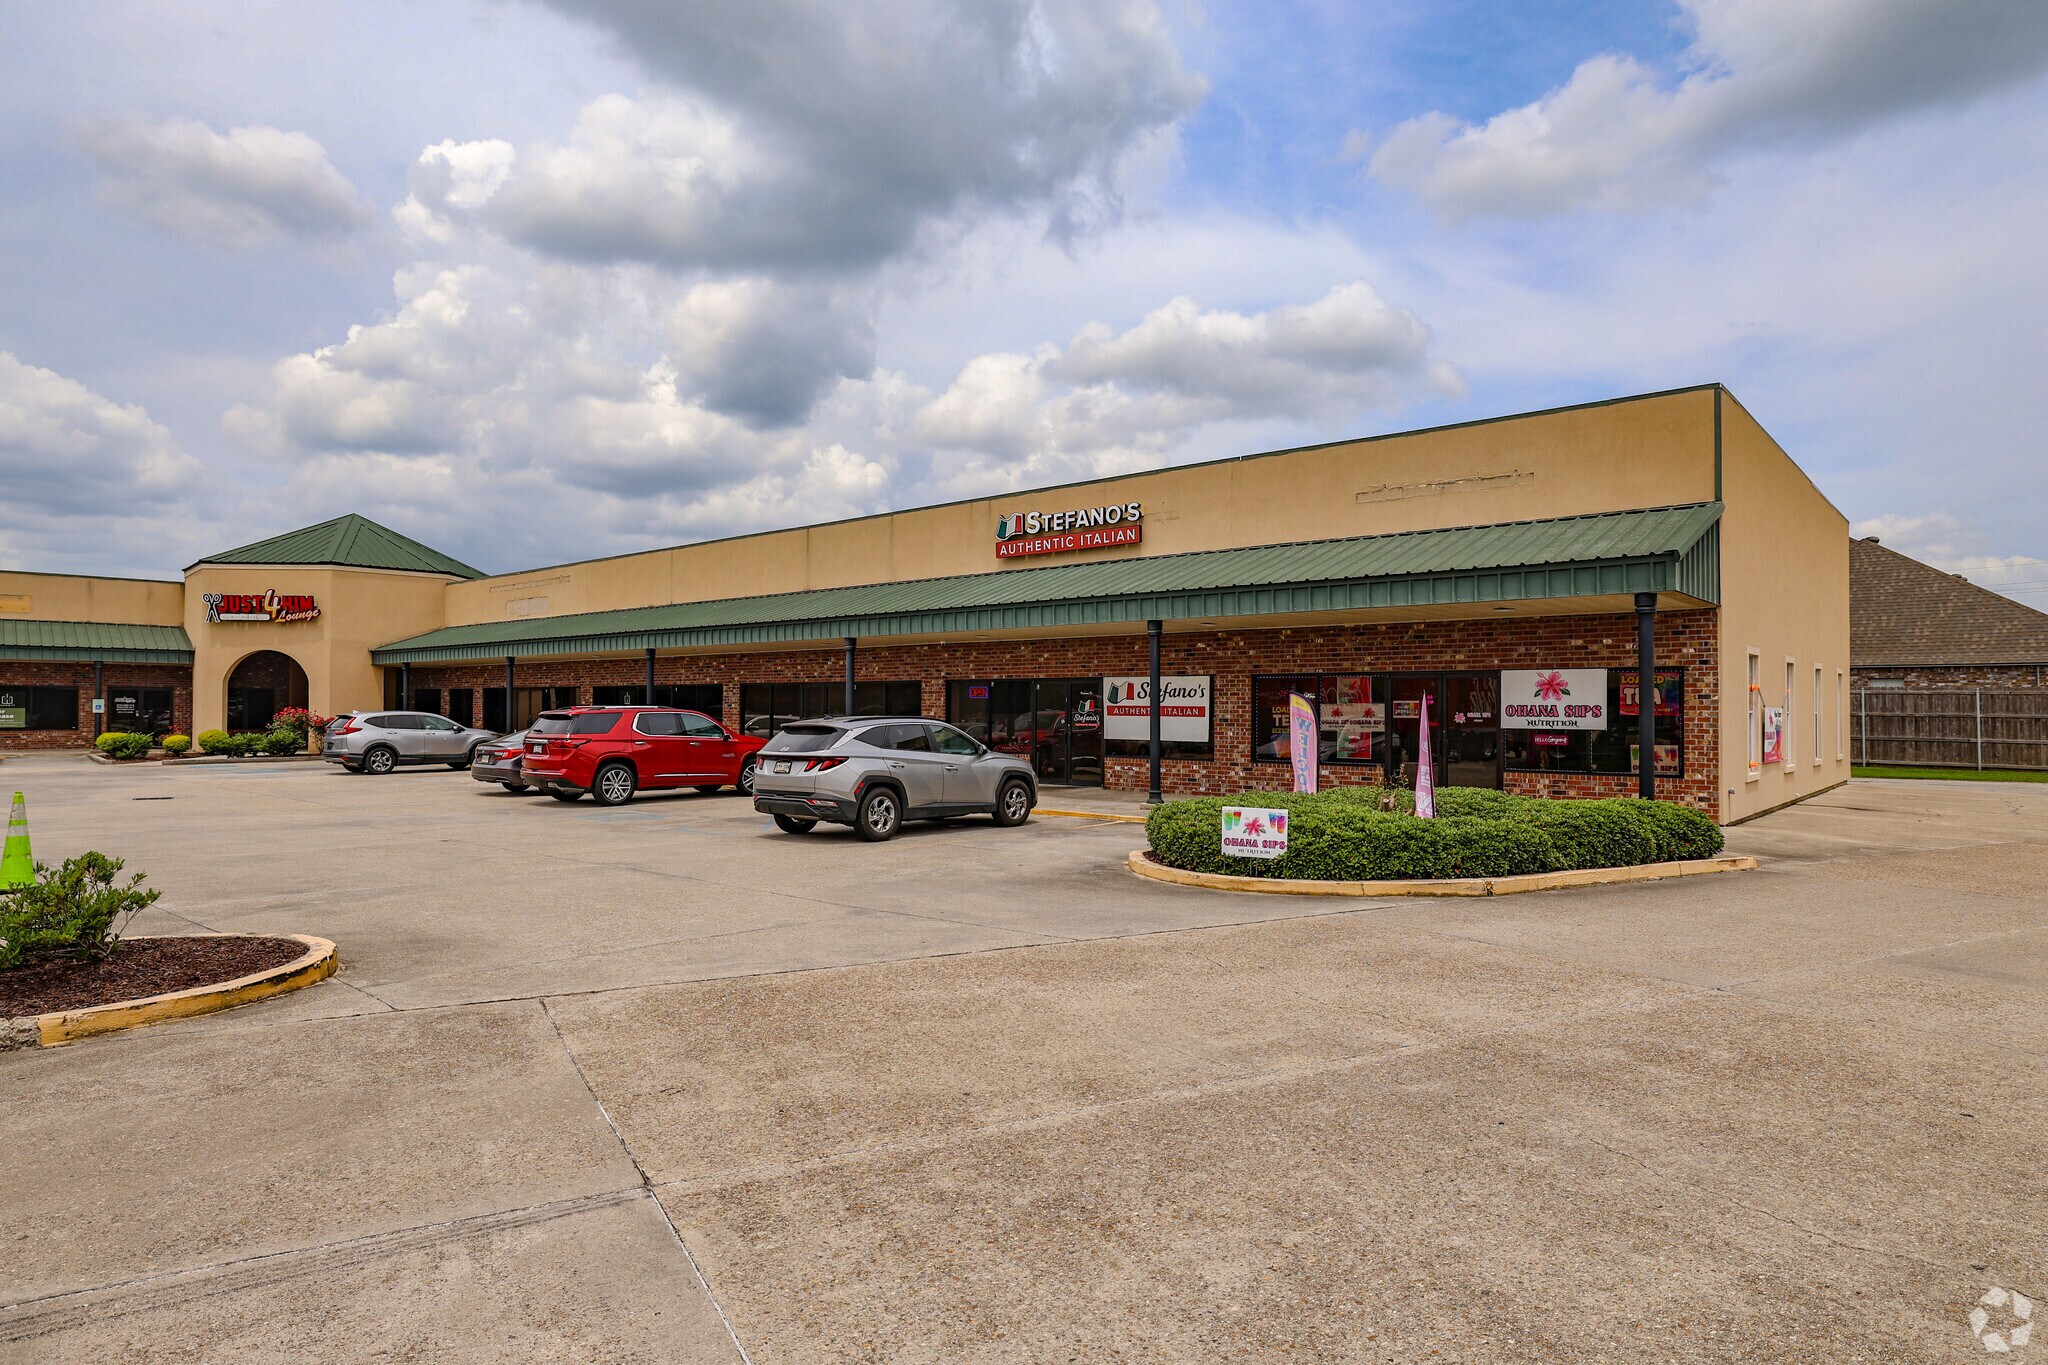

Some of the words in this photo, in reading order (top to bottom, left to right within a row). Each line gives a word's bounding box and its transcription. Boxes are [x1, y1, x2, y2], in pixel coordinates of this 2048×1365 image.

[1026, 502, 1141, 535] STEFANO'S
[999, 536, 1074, 556] AUTHENTIC
[1080, 528, 1136, 546] ITALIAN
[217, 594, 265, 614] JUST
[263, 588, 282, 619] 4
[281, 595, 315, 613] HIM
[274, 608, 322, 624] Lounge
[1164, 707, 1199, 716] ITALIAN
[1505, 704, 1559, 718] OHANA
[1564, 704, 1602, 718] SIPS
[1526, 718, 1580, 728] NUTRITION
[1224, 837, 1259, 848] OHANA
[1262, 840, 1286, 849] SIPS
